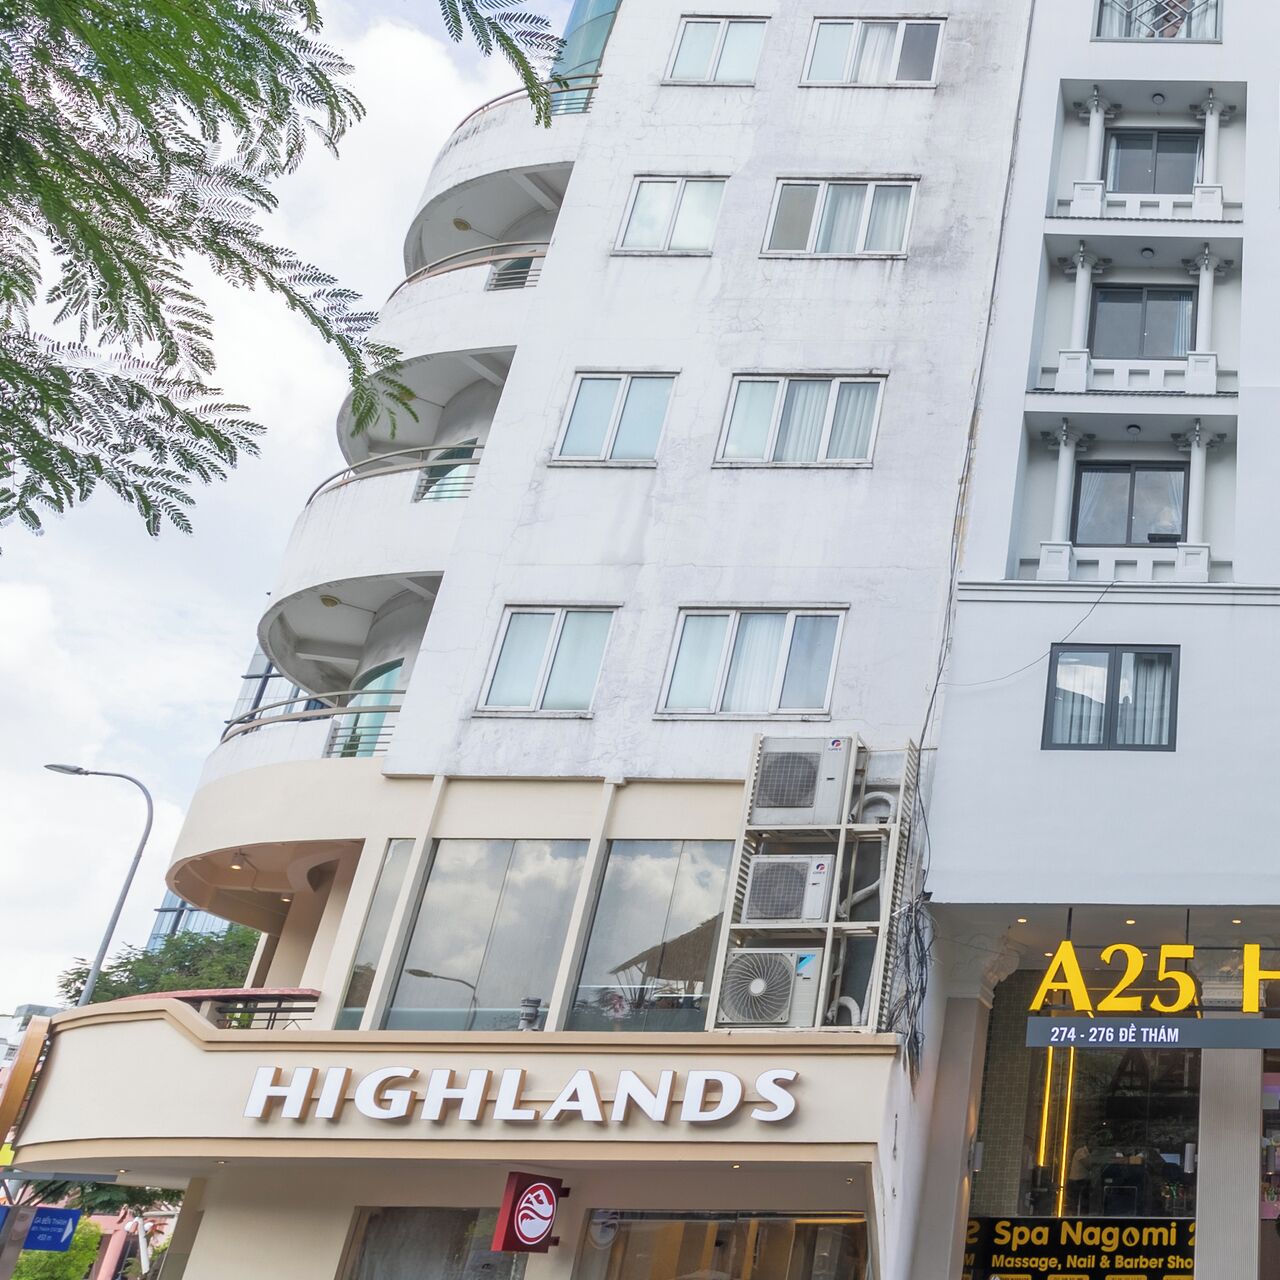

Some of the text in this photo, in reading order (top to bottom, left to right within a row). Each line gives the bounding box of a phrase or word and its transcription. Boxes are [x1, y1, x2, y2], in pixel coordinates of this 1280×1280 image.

[1029, 940, 1197, 1013] A25
[1051, 1026, 1076, 1042] 274
[1088, 1026, 1114, 1042] 276
[1119, 1023, 1137, 1043] ĐỀ
[1141, 1024, 1179, 1043] THÁM
[243, 1065, 800, 1124] HIGHLANDS
[994, 1221, 1049, 1252] Spa
[1060, 1221, 1176, 1252] Nagomi
[992, 1254, 1194, 1271] Massage, Nail & Barber Sho
